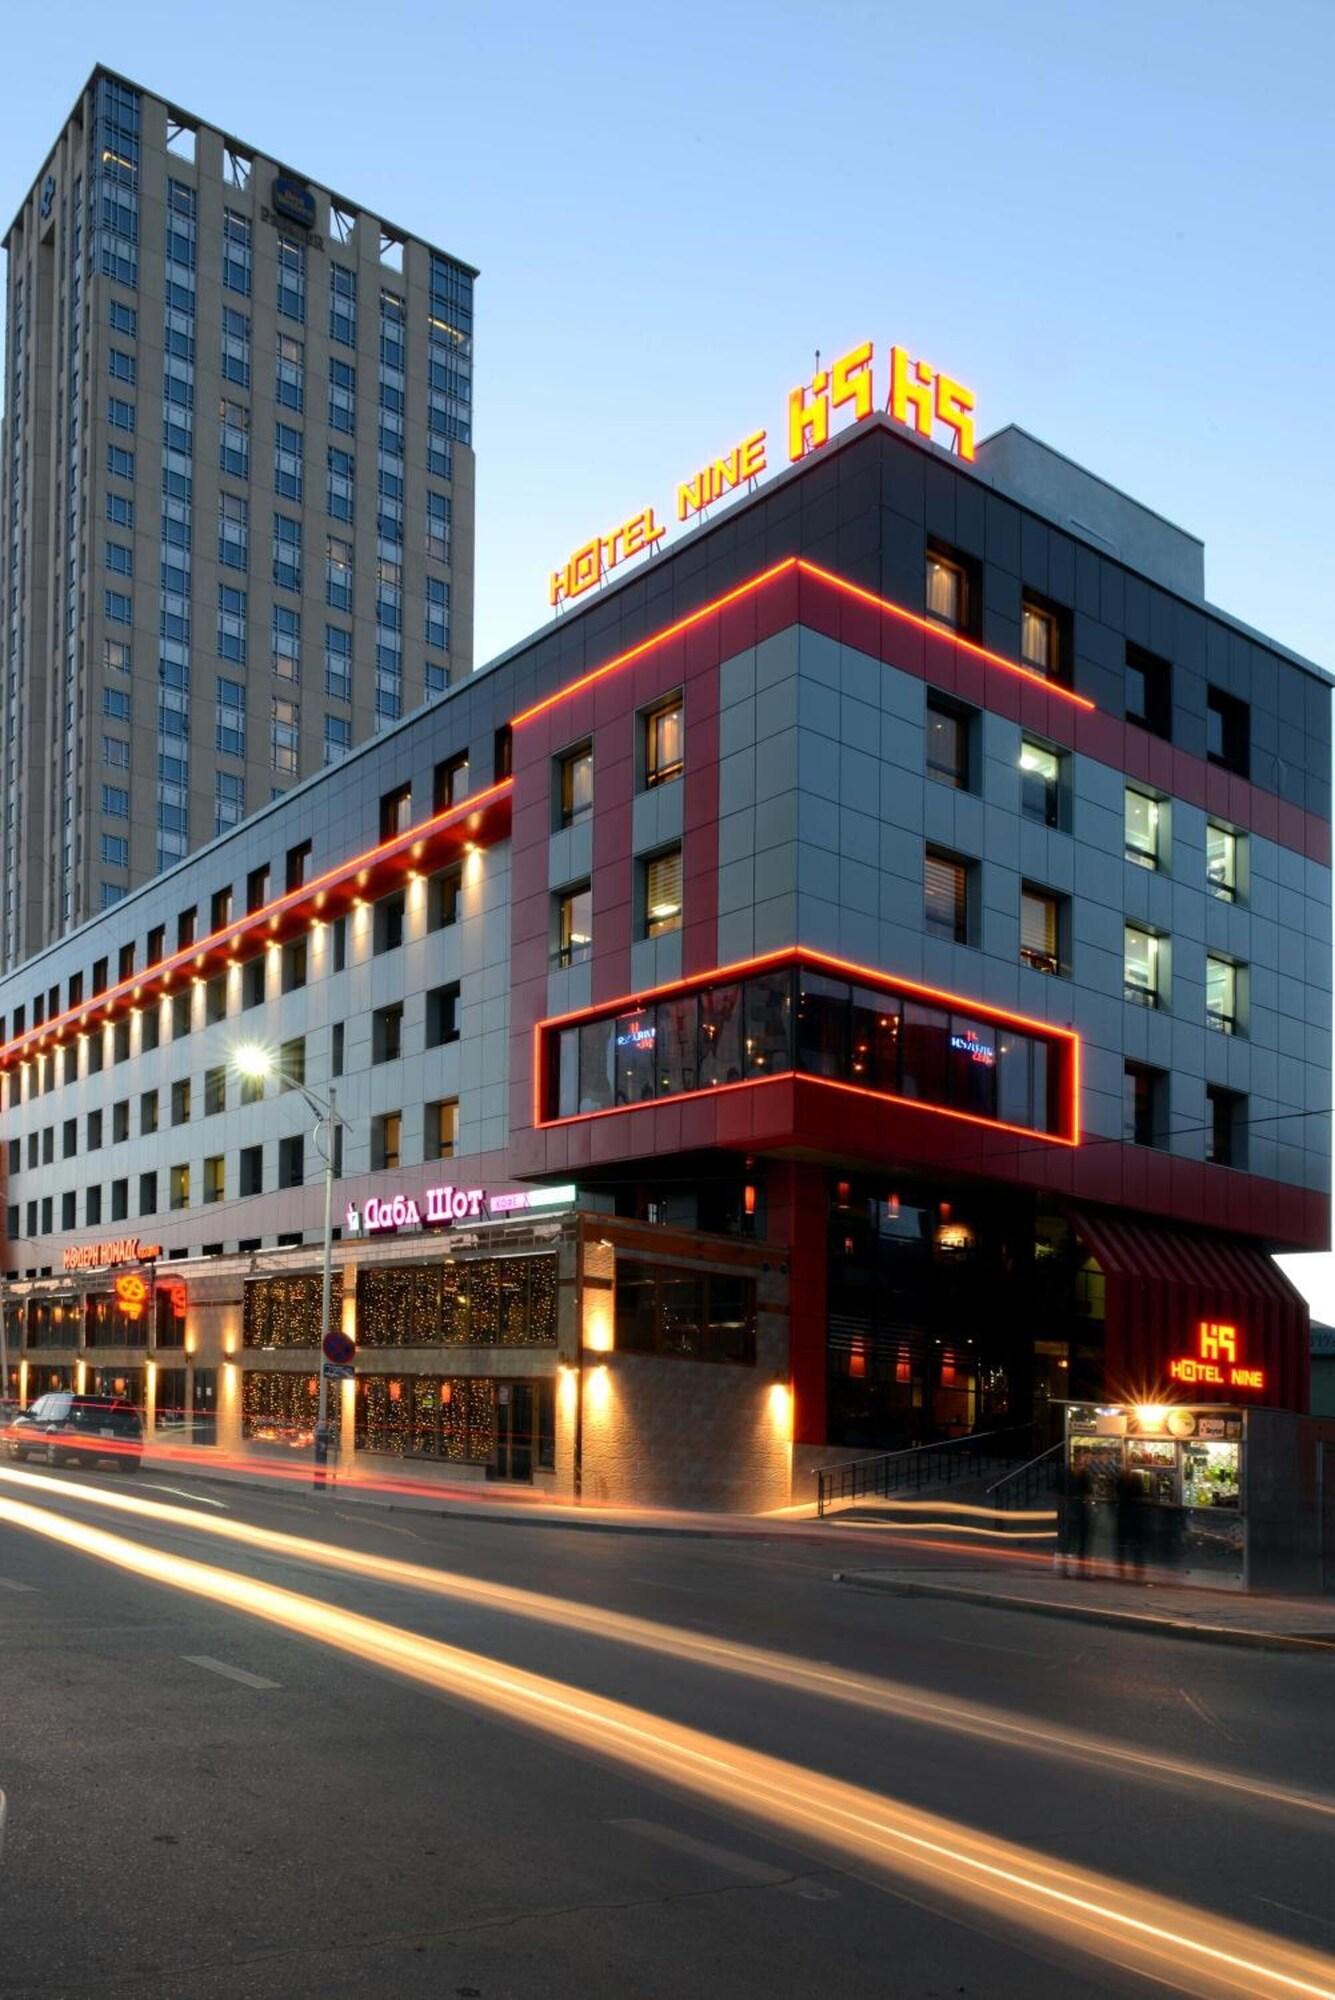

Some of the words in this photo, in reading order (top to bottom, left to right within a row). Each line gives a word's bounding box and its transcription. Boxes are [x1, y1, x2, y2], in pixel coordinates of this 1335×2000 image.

[549, 507, 665, 606] HOTEL
[677, 429, 767, 521] NINE
[426, 1187, 483, 1221] Шот
[1171, 1360, 1224, 1383] HOTEL
[1231, 1368, 1264, 1388] NINE
